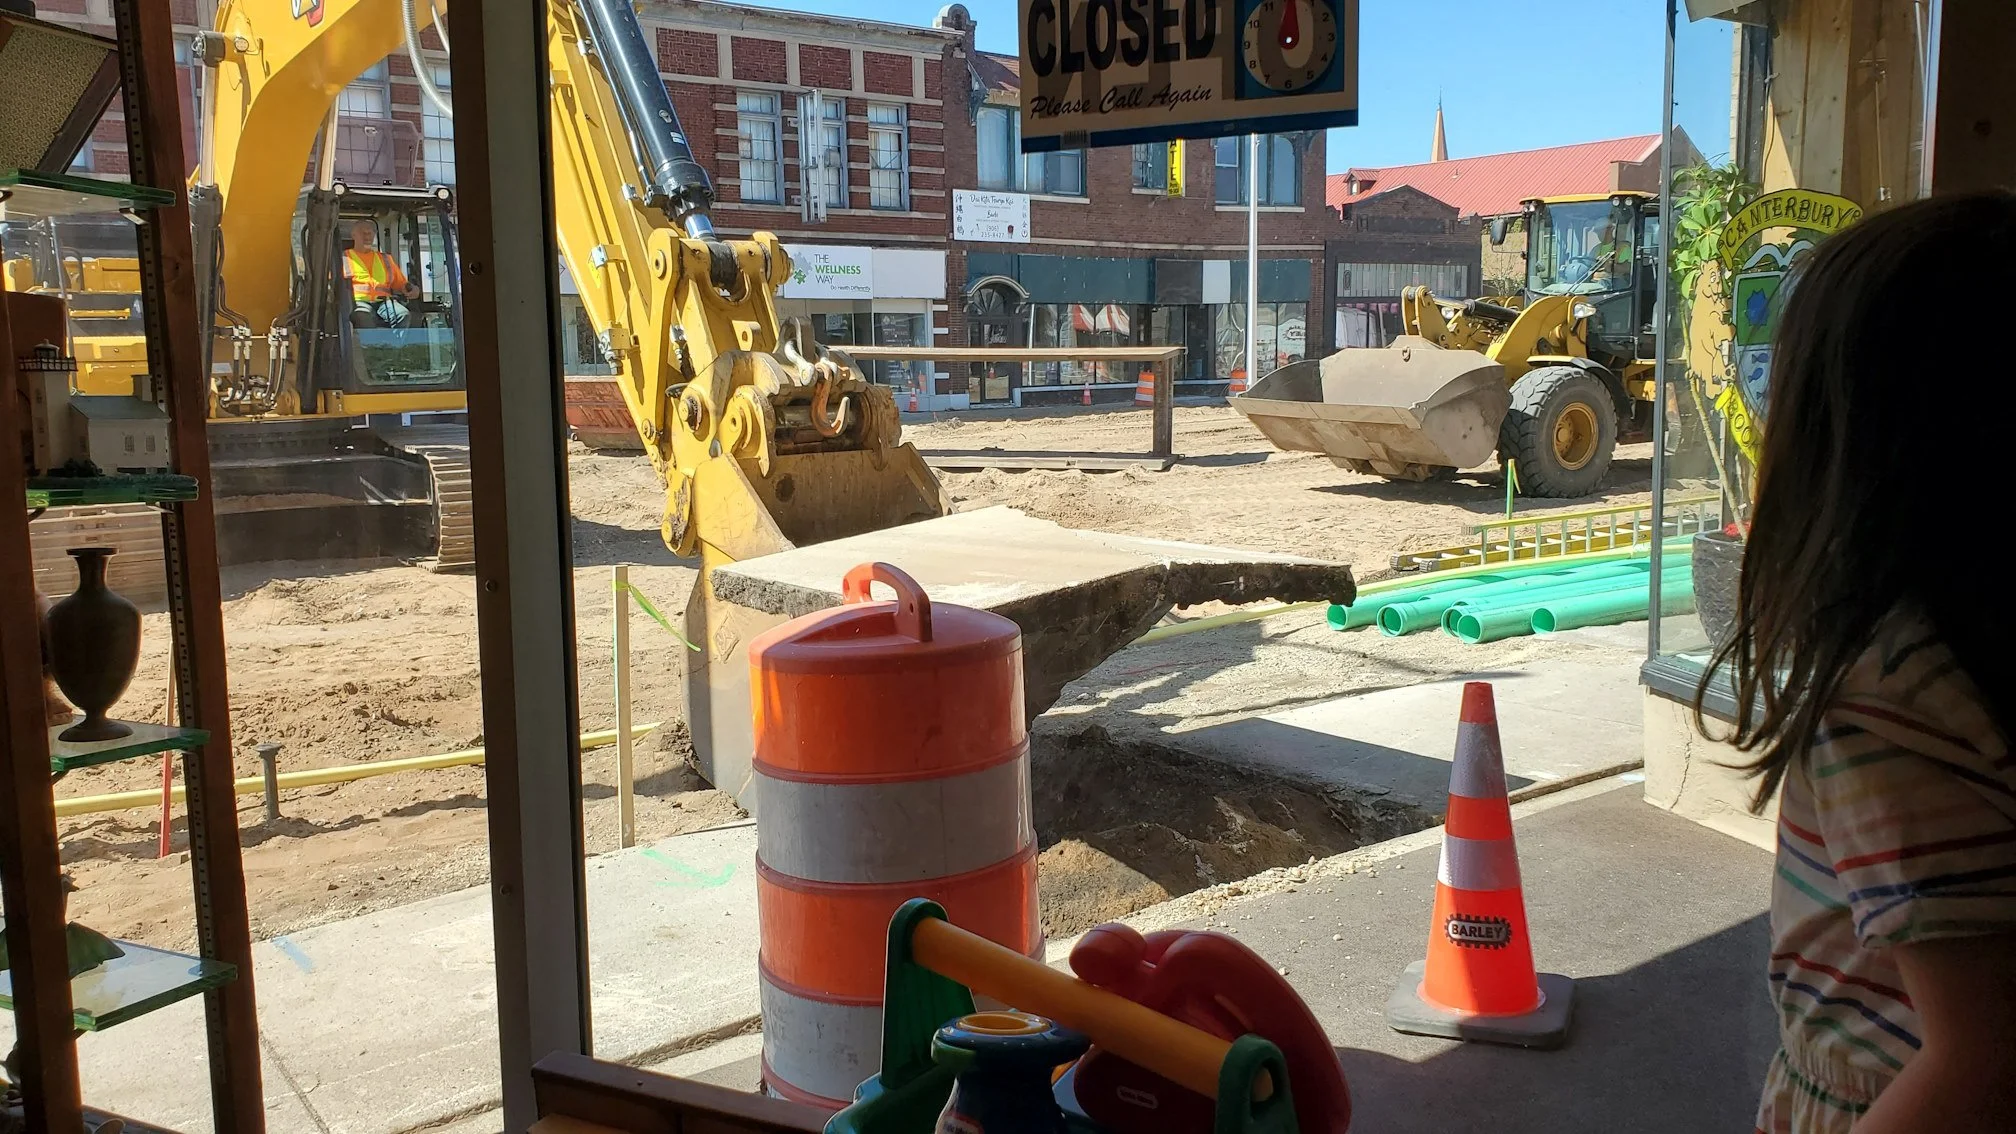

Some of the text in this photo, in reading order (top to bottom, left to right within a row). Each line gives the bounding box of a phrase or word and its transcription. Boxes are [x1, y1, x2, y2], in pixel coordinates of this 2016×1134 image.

[1263, 2, 1274, 12] 11
[1322, 12, 1329, 22] 2
[1248, 20, 1260, 29] 10
[1027, 0, 1216, 77] CLOSED
[1327, 33, 1335, 42] 3
[1243, 41, 1251, 50] 9
[1320, 53, 1328, 62] 4
[1249, 60, 1257, 69] 8
[1263, 74, 1271, 84] 7
[1306, 70, 1314, 80] 5
[1284, 80, 1292, 89] 6
[1030, 83, 1213, 120] Please Call Again
[814, 253, 830, 264] THE
[814, 265, 862, 275] WELLNESS
[815, 275, 835, 285] WAY
[1452, 924, 1503, 938] BARLEY
